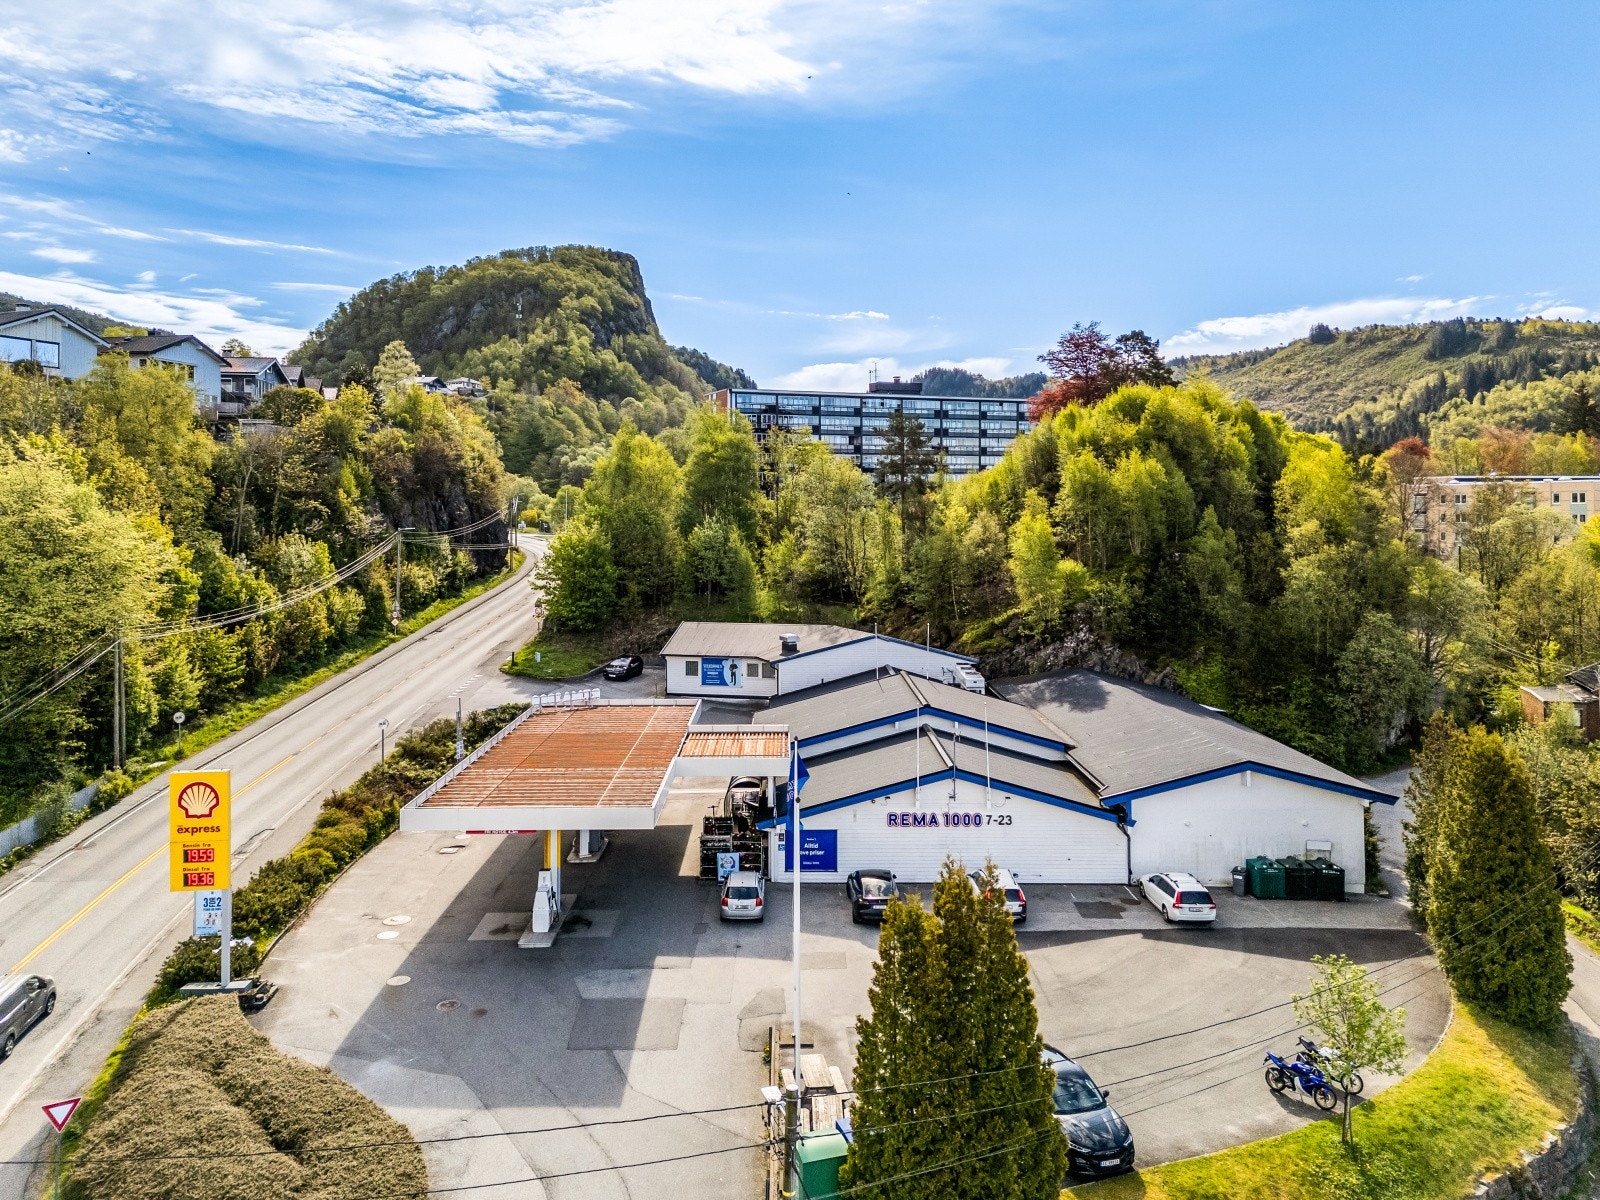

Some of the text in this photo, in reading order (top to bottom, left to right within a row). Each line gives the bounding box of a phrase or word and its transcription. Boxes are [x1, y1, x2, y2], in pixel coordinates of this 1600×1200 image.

[887, 812, 1012, 827] REMA 1000 7-23
[177, 825, 220, 836] express
[203, 897, 208, 907] 3
[217, 897, 222, 907] 2
